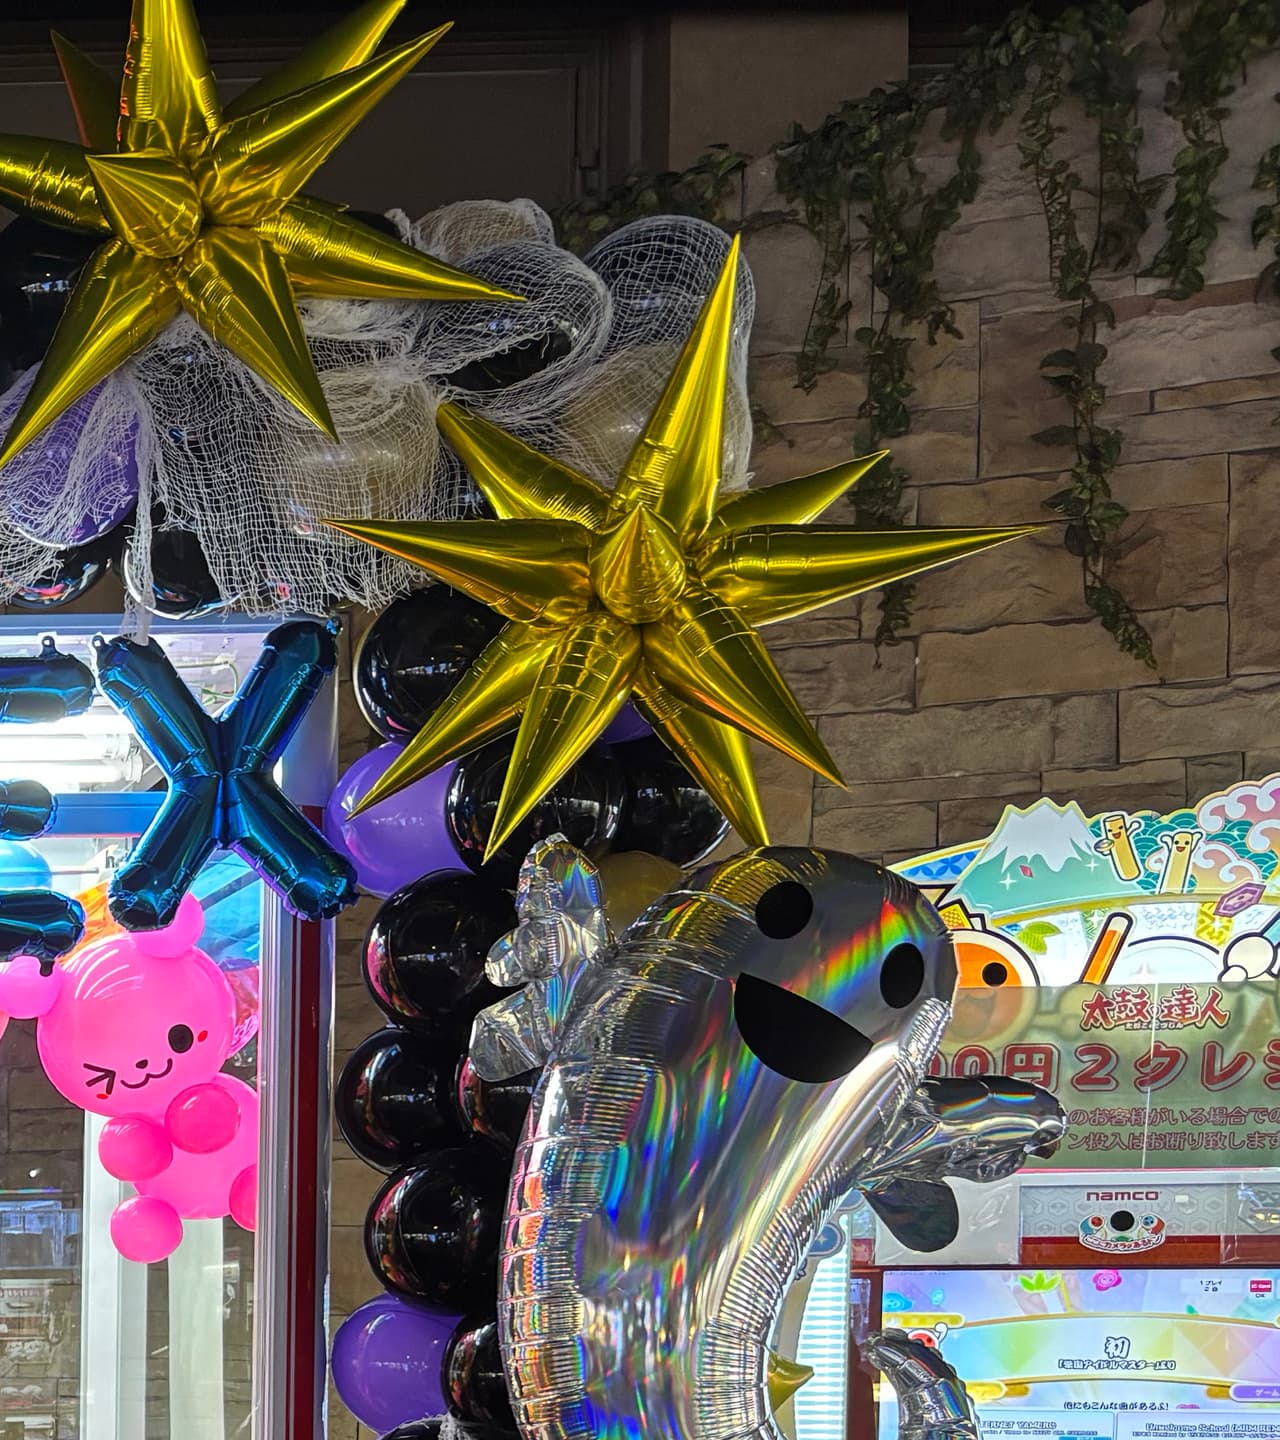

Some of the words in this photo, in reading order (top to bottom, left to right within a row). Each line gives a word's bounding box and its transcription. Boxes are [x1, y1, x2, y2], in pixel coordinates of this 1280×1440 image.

[1080, 984, 1230, 1031] 太鼓の達人
[1086, 1191, 1159, 1201] namco
